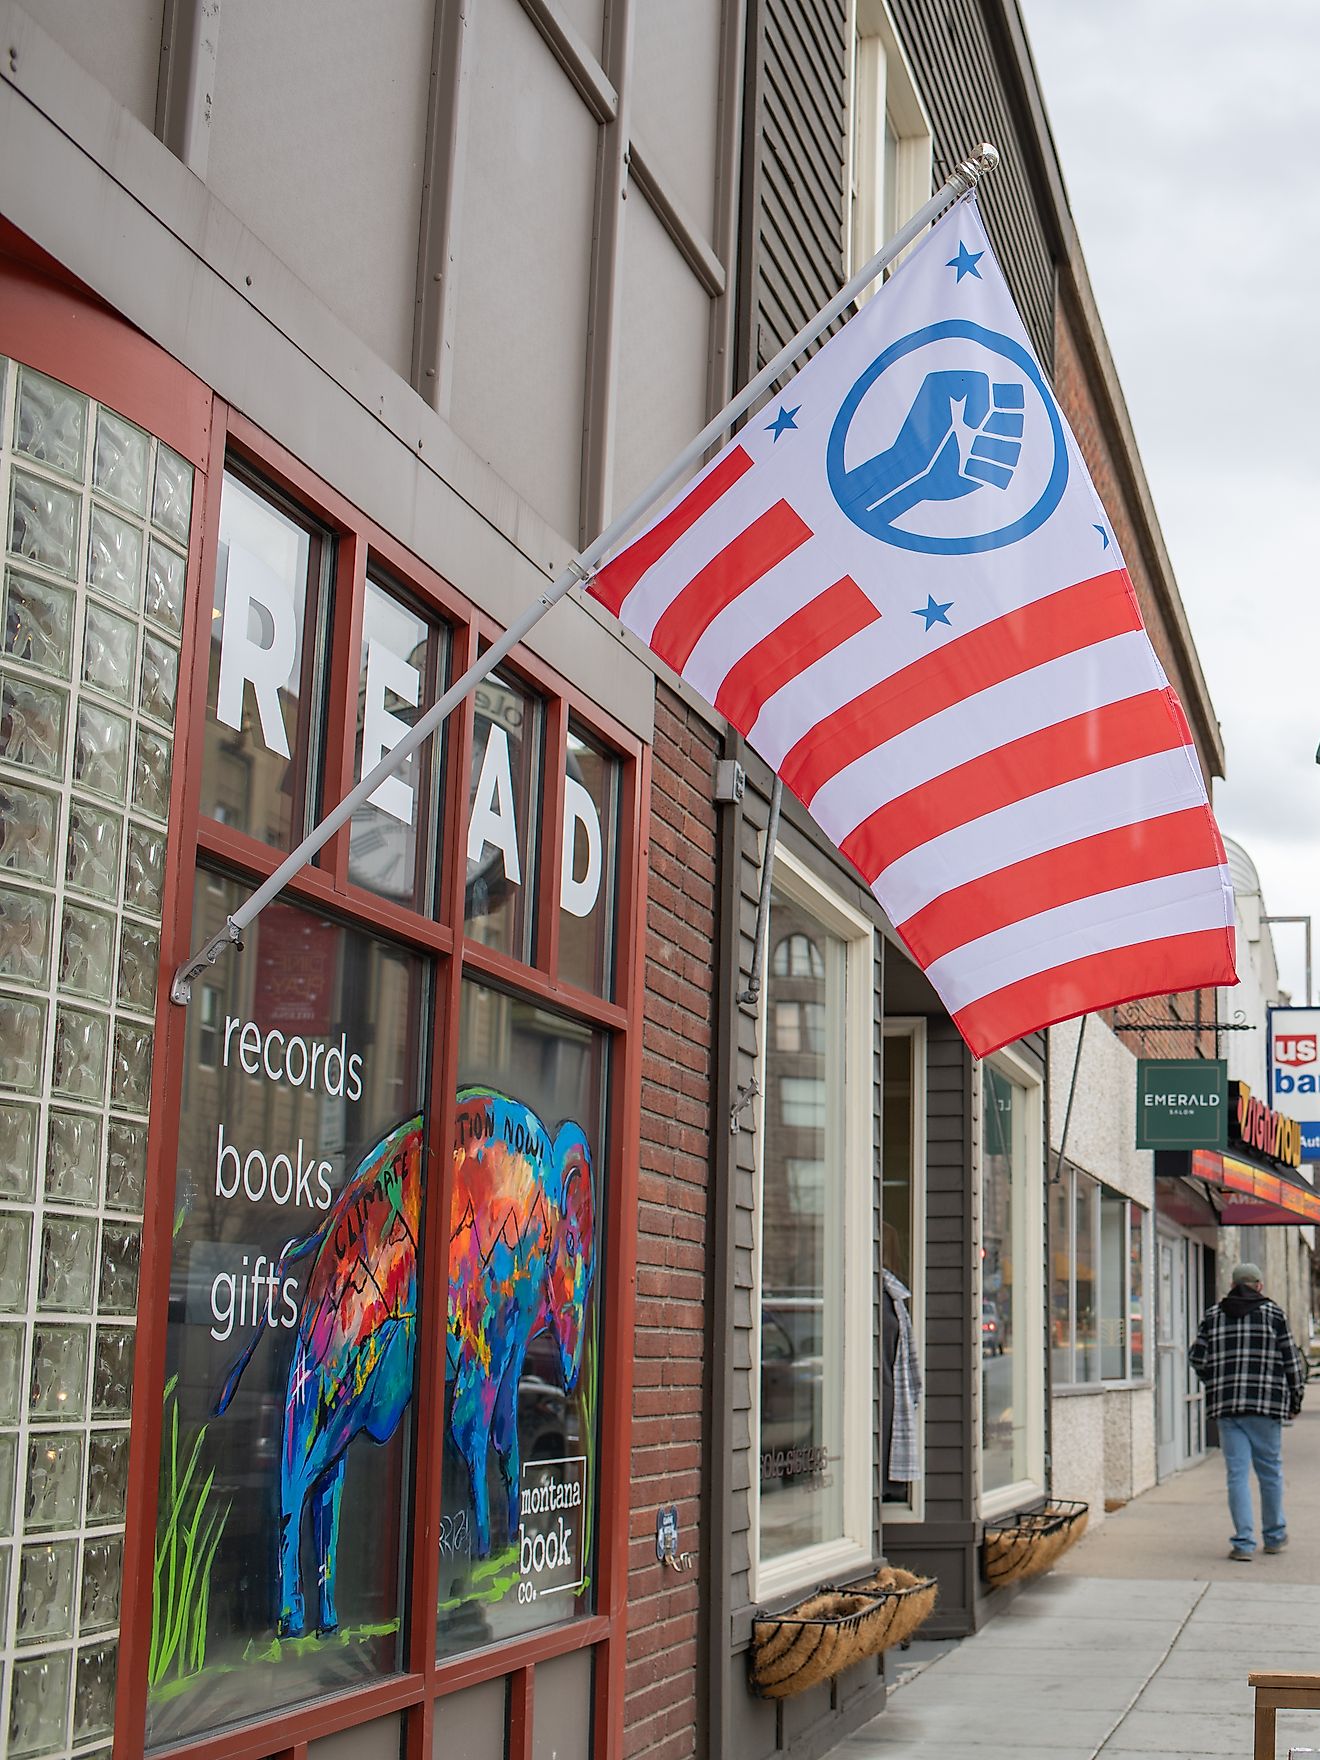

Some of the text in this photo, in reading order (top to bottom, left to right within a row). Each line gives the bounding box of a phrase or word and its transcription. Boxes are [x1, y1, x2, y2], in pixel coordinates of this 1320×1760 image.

[217, 540, 603, 918] READ
[223, 1015, 364, 1101] records
[1144, 1093, 1220, 1107] EMERALD
[215, 1123, 333, 1211] books
[504, 1116, 544, 1167] NOW!
[335, 1151, 408, 1260] CLIMATE
[210, 1255, 299, 1342] gifts
[521, 1476, 581, 1516] montana
[519, 1516, 572, 1575] book
